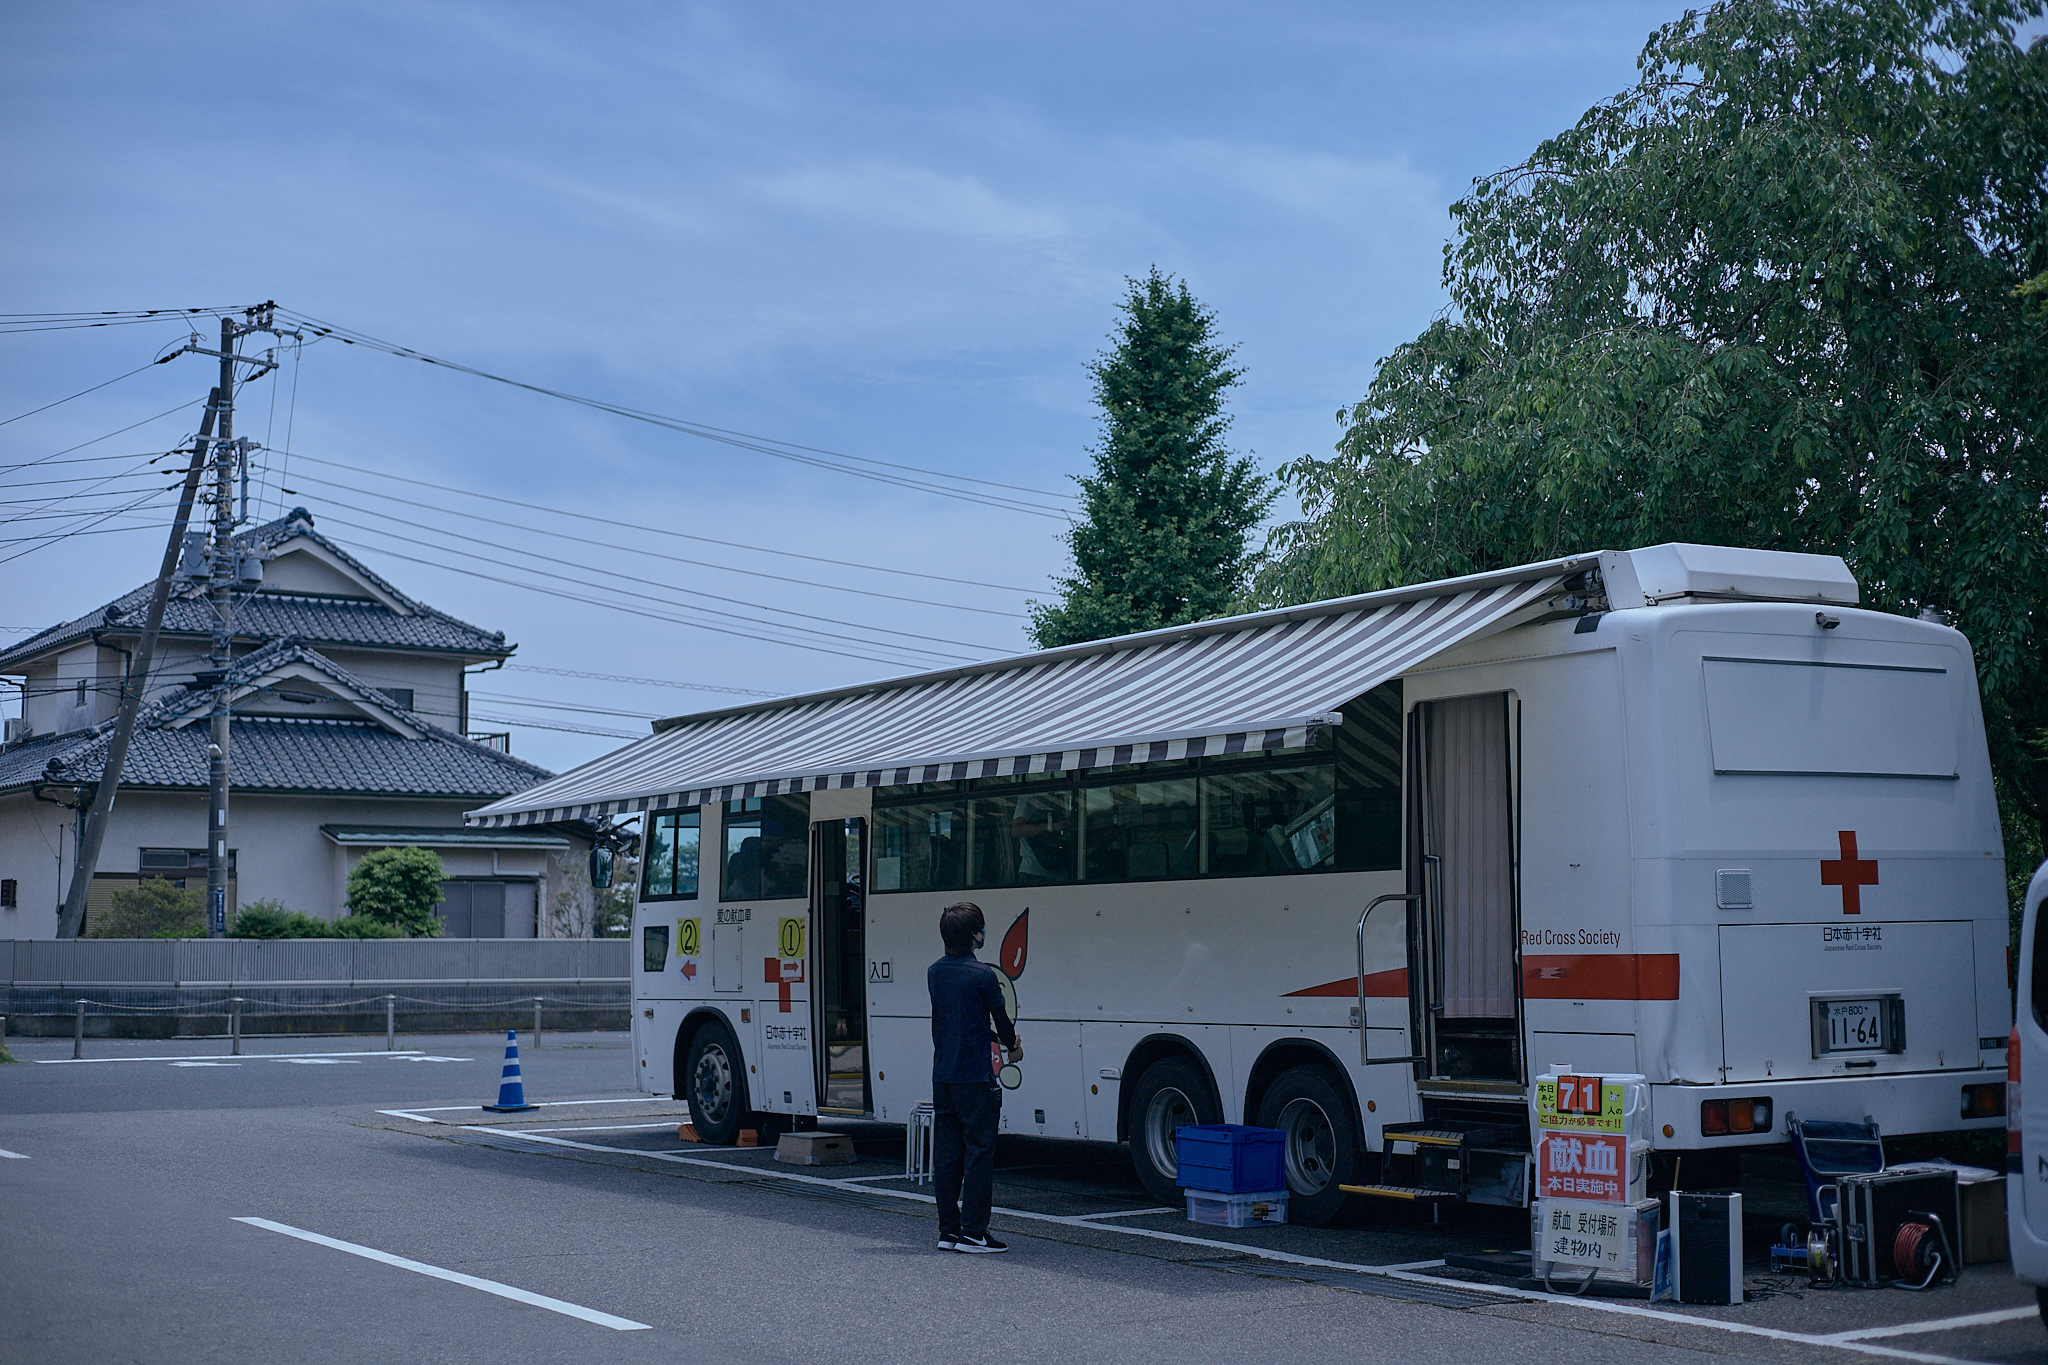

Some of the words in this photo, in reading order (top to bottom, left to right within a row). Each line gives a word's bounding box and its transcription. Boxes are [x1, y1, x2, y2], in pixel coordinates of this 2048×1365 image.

[717, 909, 752, 923] 愛の献血車
[1521, 930, 1542, 945] Red
[1545, 929, 1576, 945] Cross
[1578, 929, 1621, 948] Society
[1823, 926, 1882, 941] 日本赤十字社
[1824, 944, 1845, 952] Japanese
[1866, 943, 1882, 951] Society
[870, 961, 890, 979] 入口
[766, 1025, 807, 1040] 日本赤十字社
[1538, 1084, 1554, 1093] 本日
[1607, 1106, 1623, 1115] 人の
[1548, 1137, 1618, 1176] 献血
[1547, 1176, 1618, 1195] 本日実施中
[1552, 1209, 1571, 1230] 献血
[1577, 1212, 1618, 1237] 受付場所
[1553, 1236, 1602, 1259] 建物内
[1607, 1252, 1618, 1261] です
